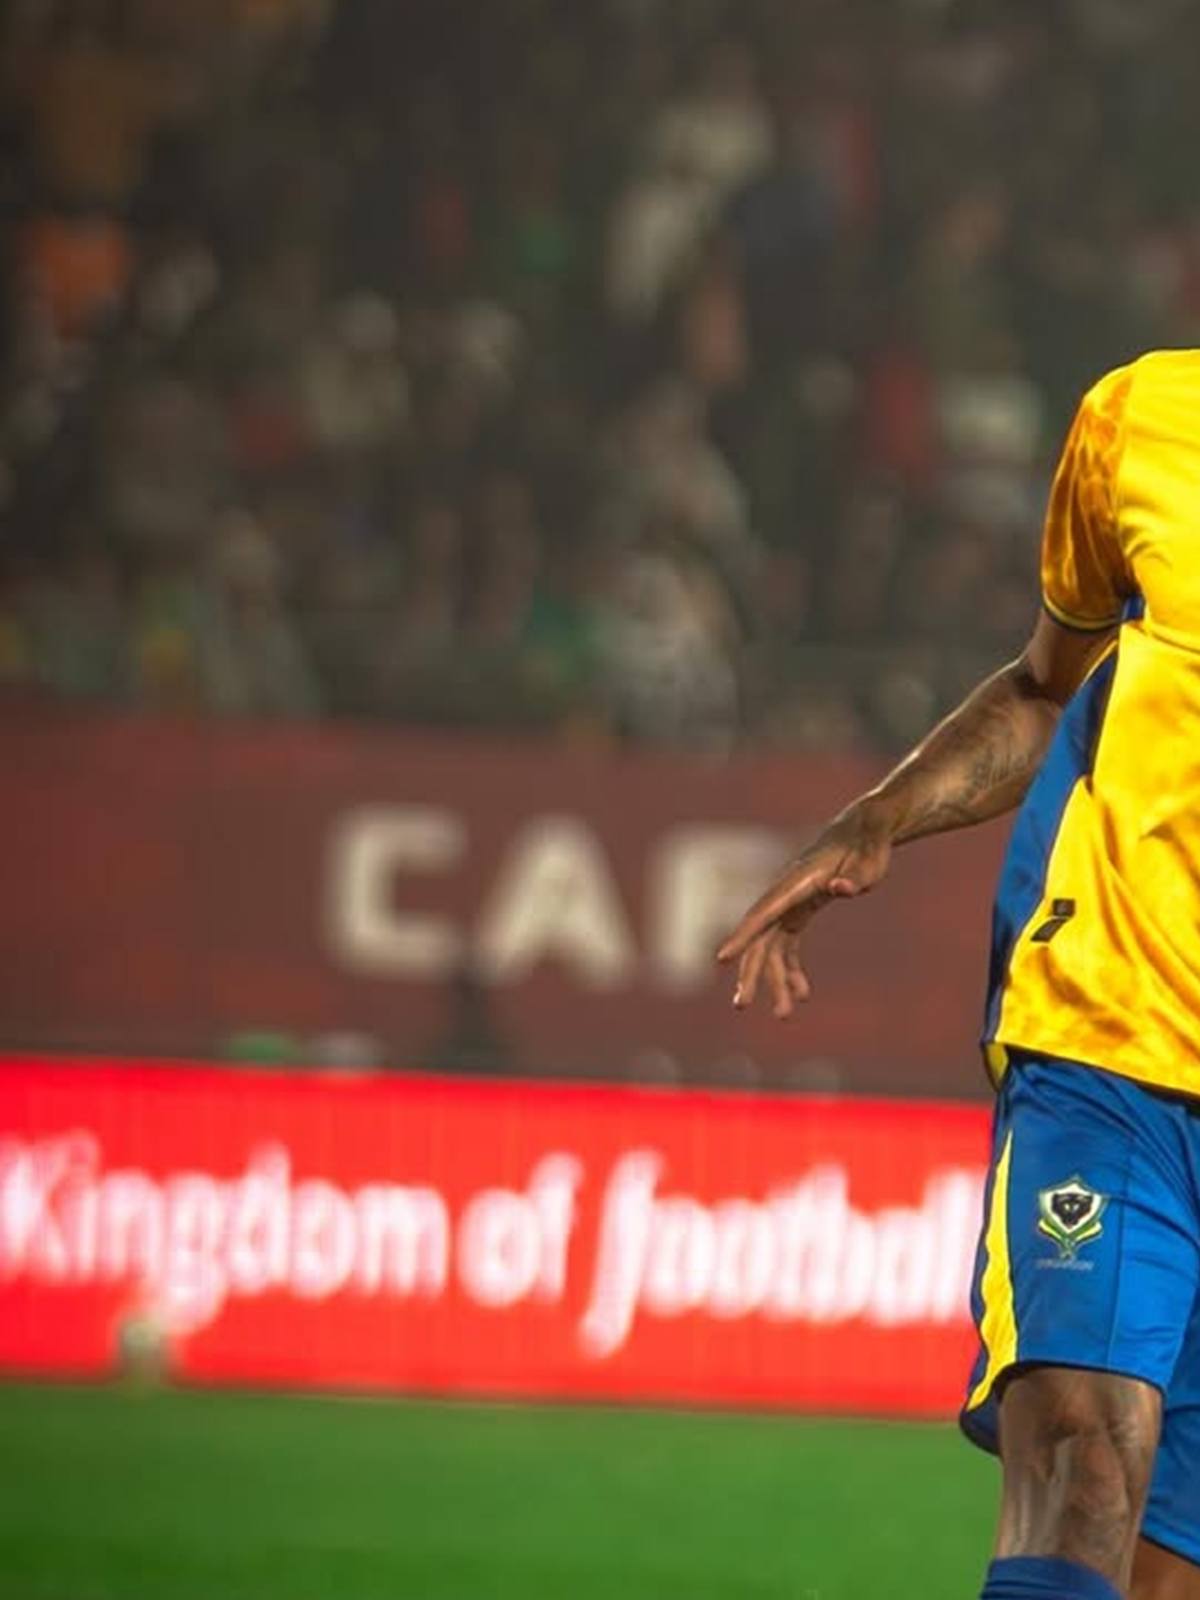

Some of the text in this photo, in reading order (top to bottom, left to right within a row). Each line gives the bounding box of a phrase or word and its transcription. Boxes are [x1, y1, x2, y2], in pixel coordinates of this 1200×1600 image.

[325, 804, 790, 995] CAF
[0, 1126, 450, 1338] Kingdom
[455, 1150, 585, 1308] of
